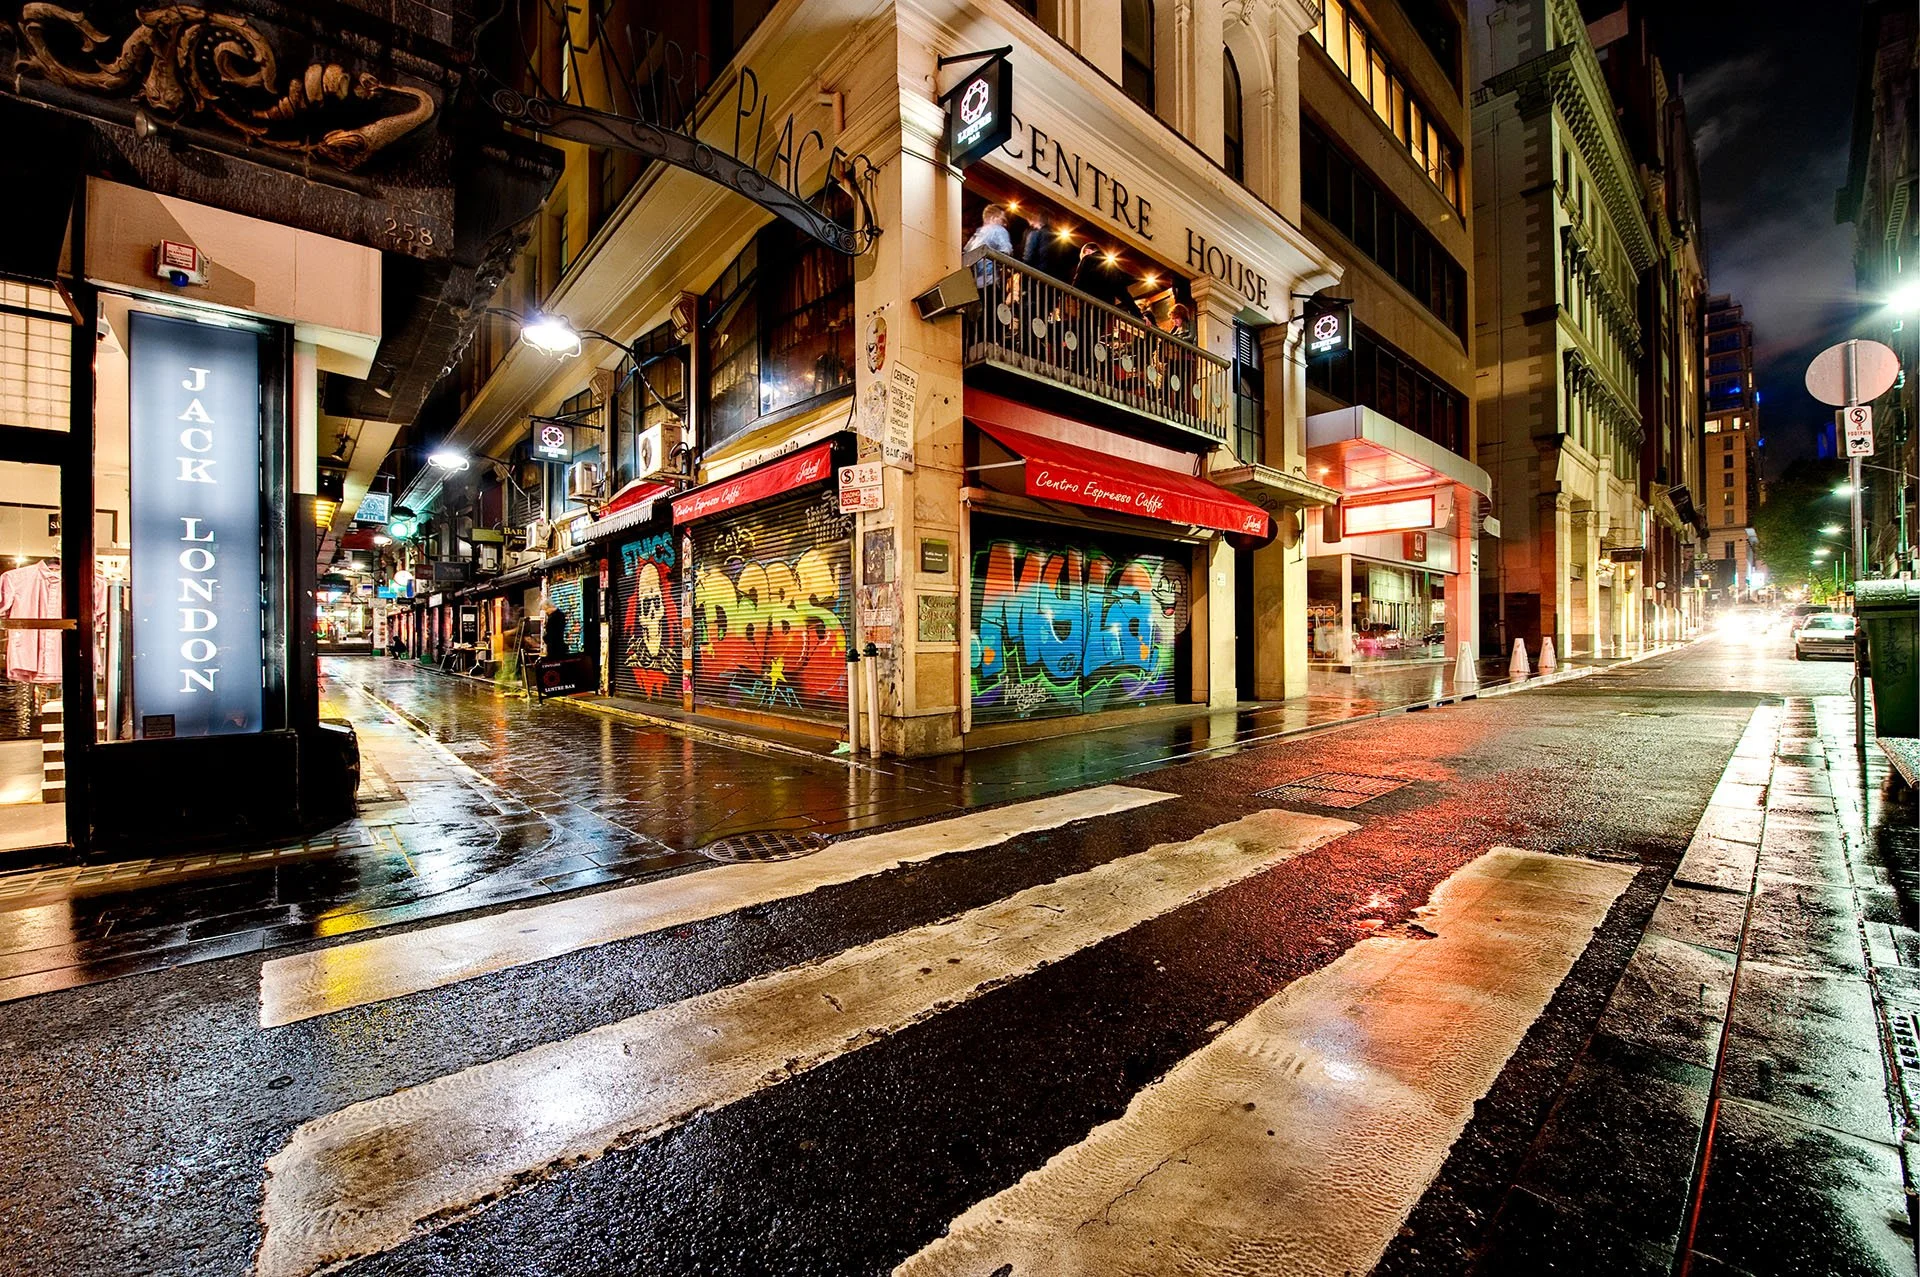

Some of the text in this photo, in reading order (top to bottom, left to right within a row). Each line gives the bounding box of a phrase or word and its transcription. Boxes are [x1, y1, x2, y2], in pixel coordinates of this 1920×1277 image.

[734, 63, 848, 215] PLACE
[384, 217, 433, 246] 258
[1186, 227, 1269, 311] HOUSE
[893, 368, 911, 386] CENTRE
[177, 367, 216, 483] JACK
[842, 497, 860, 505] ZONE
[1035, 471, 1079, 493] Centro
[1083, 481, 1131, 504] Espresso
[178, 517, 220, 693] LONDON
